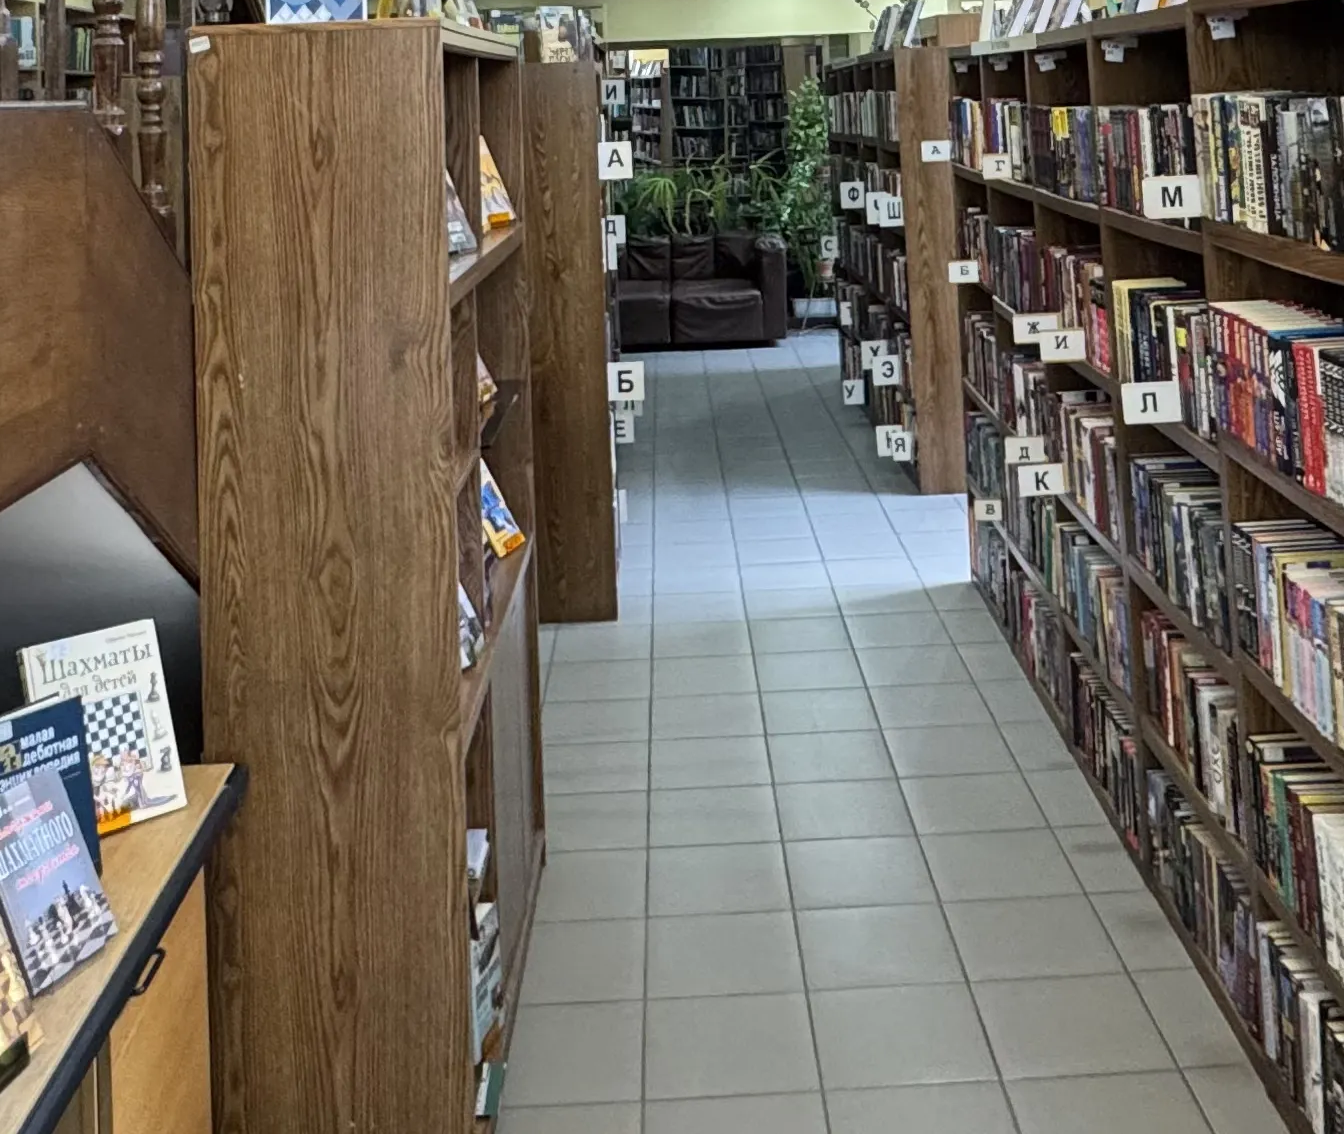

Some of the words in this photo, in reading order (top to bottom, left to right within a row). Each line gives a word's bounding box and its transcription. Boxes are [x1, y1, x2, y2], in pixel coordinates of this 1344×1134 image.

[605, 83, 617, 100] И
[607, 148, 625, 168] А
[931, 145, 942, 155] А
[994, 160, 1006, 172] Г
[848, 186, 860, 202] Ф
[1161, 185, 1183, 208] М
[824, 239, 833, 252] С
[960, 265, 970, 277] Б
[1027, 321, 1041, 334] Ж
[1054, 335, 1070, 350] И
[881, 360, 895, 378] Э
[617, 370, 635, 393] Б
[1140, 391, 1159, 413] Л
[895, 437, 906, 453] Я
[1018, 446, 1031, 461] Д
[1034, 470, 1050, 491] К
[985, 503, 996, 515] В
